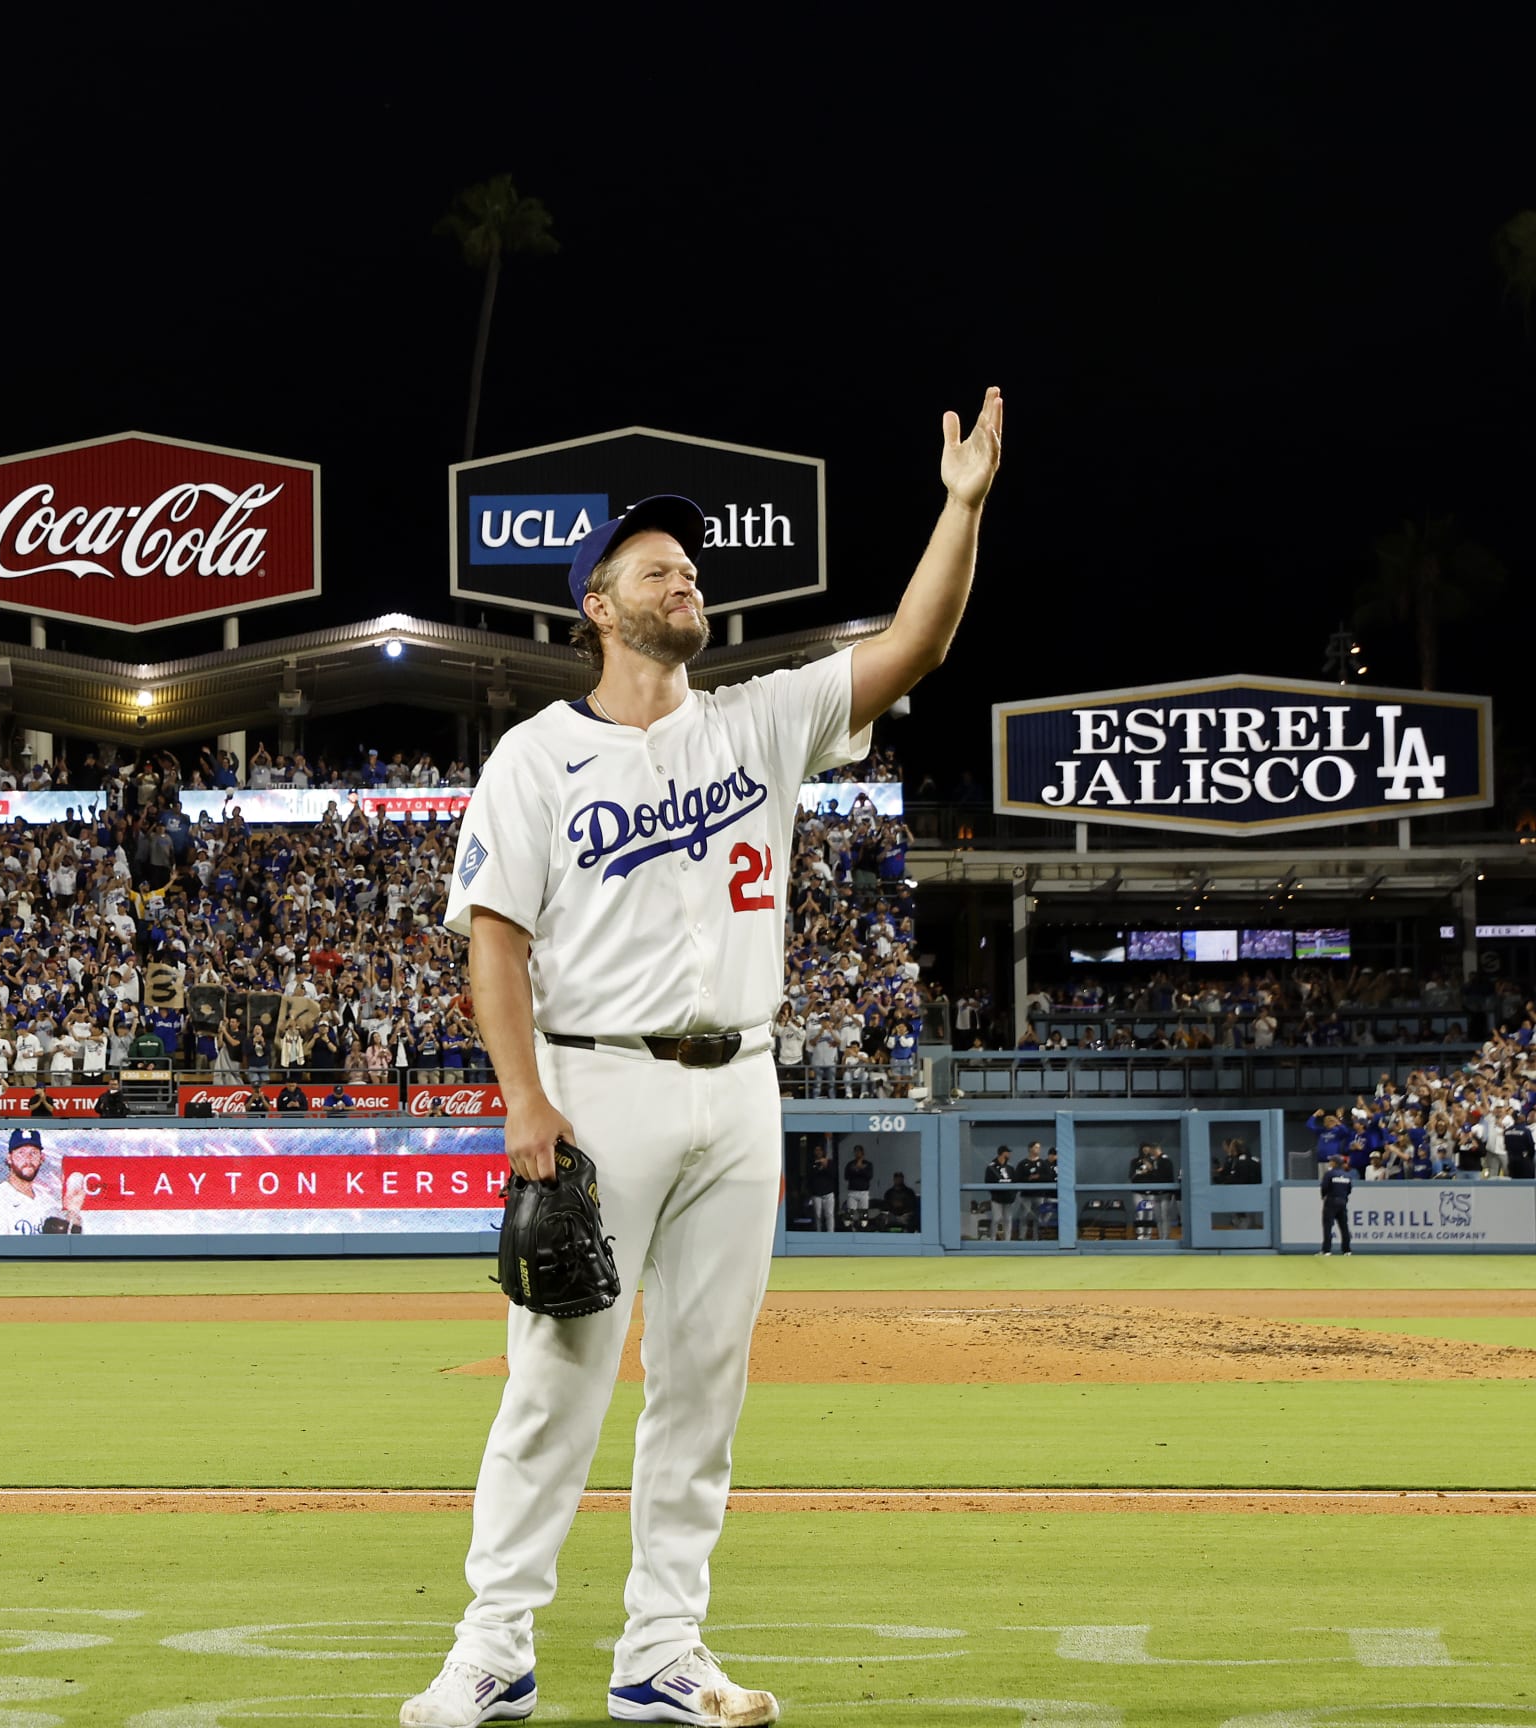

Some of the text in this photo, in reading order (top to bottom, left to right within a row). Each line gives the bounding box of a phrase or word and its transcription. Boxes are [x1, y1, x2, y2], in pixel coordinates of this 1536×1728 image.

[481, 508, 593, 548] UCLA
[1072, 706, 1370, 755] ESTREL
[1041, 755, 1357, 806] JALISCO
[567, 766, 768, 887] Dodgers
[20, 1098, 68, 1110] ERY
[71, 1098, 99, 1110] TIM
[492, 1097, 502, 1108] A
[868, 1116, 906, 1132] 360
[83, 1172, 317, 1195] CLAYTON
[1371, 1231, 1384, 1240] OF
[1387, 1231, 1433, 1240] AMERICA
[1436, 1231, 1486, 1241] COMPANY
[519, 1257, 531, 1297] A2000
